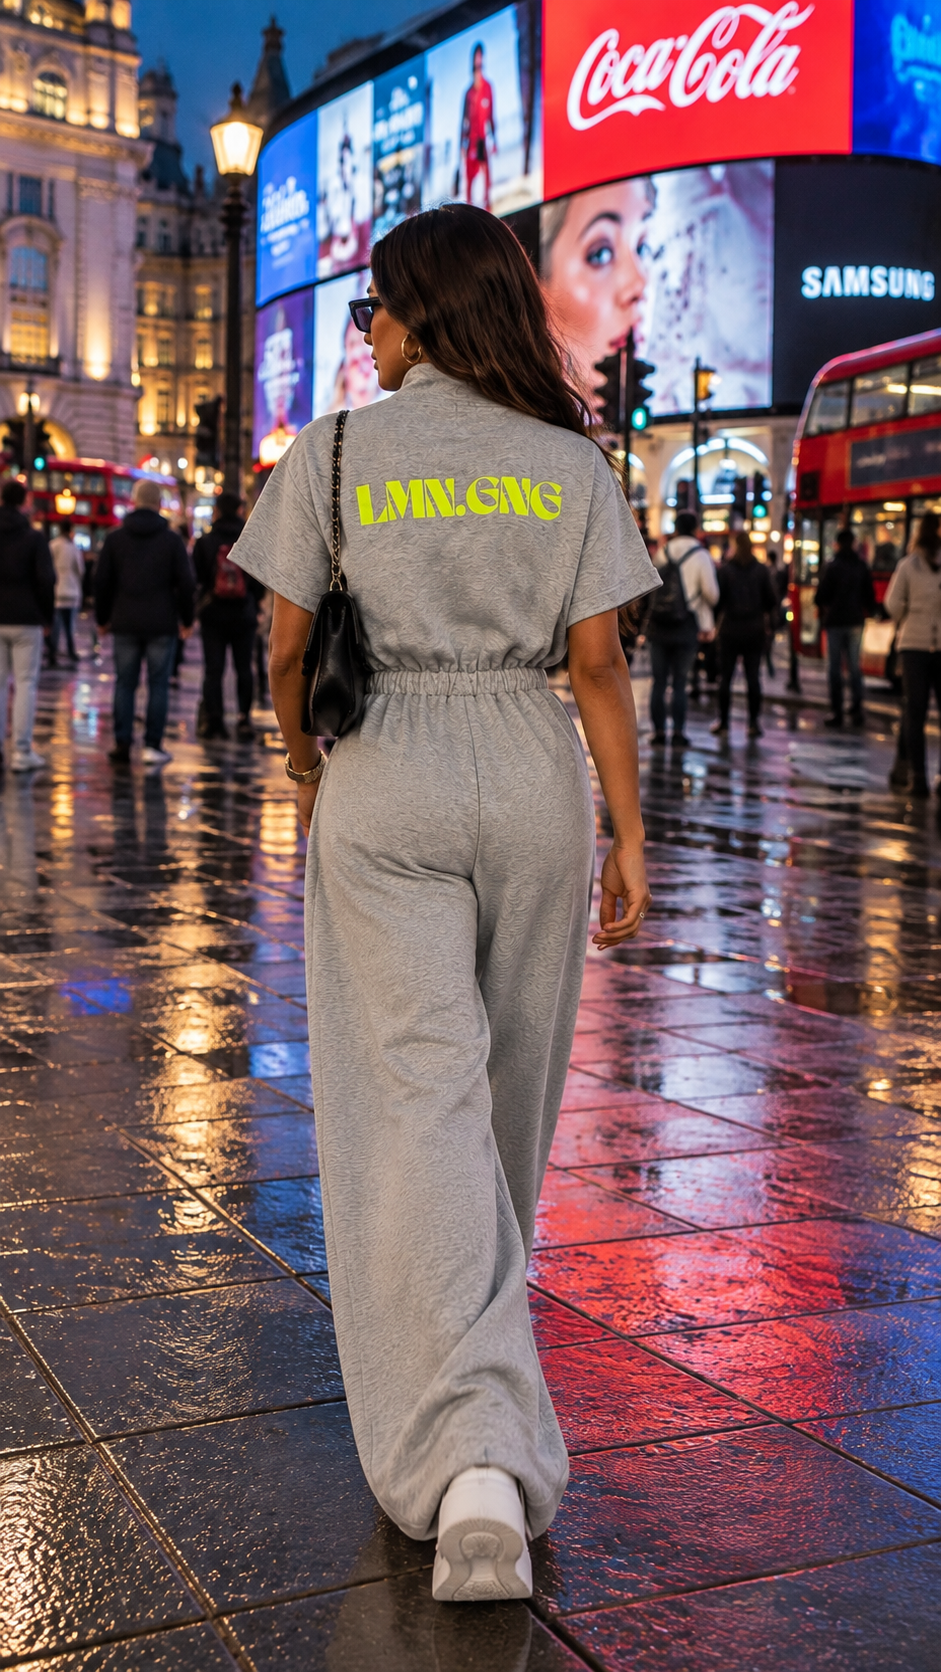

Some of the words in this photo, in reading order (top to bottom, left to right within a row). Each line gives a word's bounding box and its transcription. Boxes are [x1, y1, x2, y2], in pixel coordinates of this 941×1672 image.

[567, 1, 815, 131] Coca-Cola
[801, 265, 935, 301] SAMSUNG
[356, 476, 562, 526] LMN.GNG
